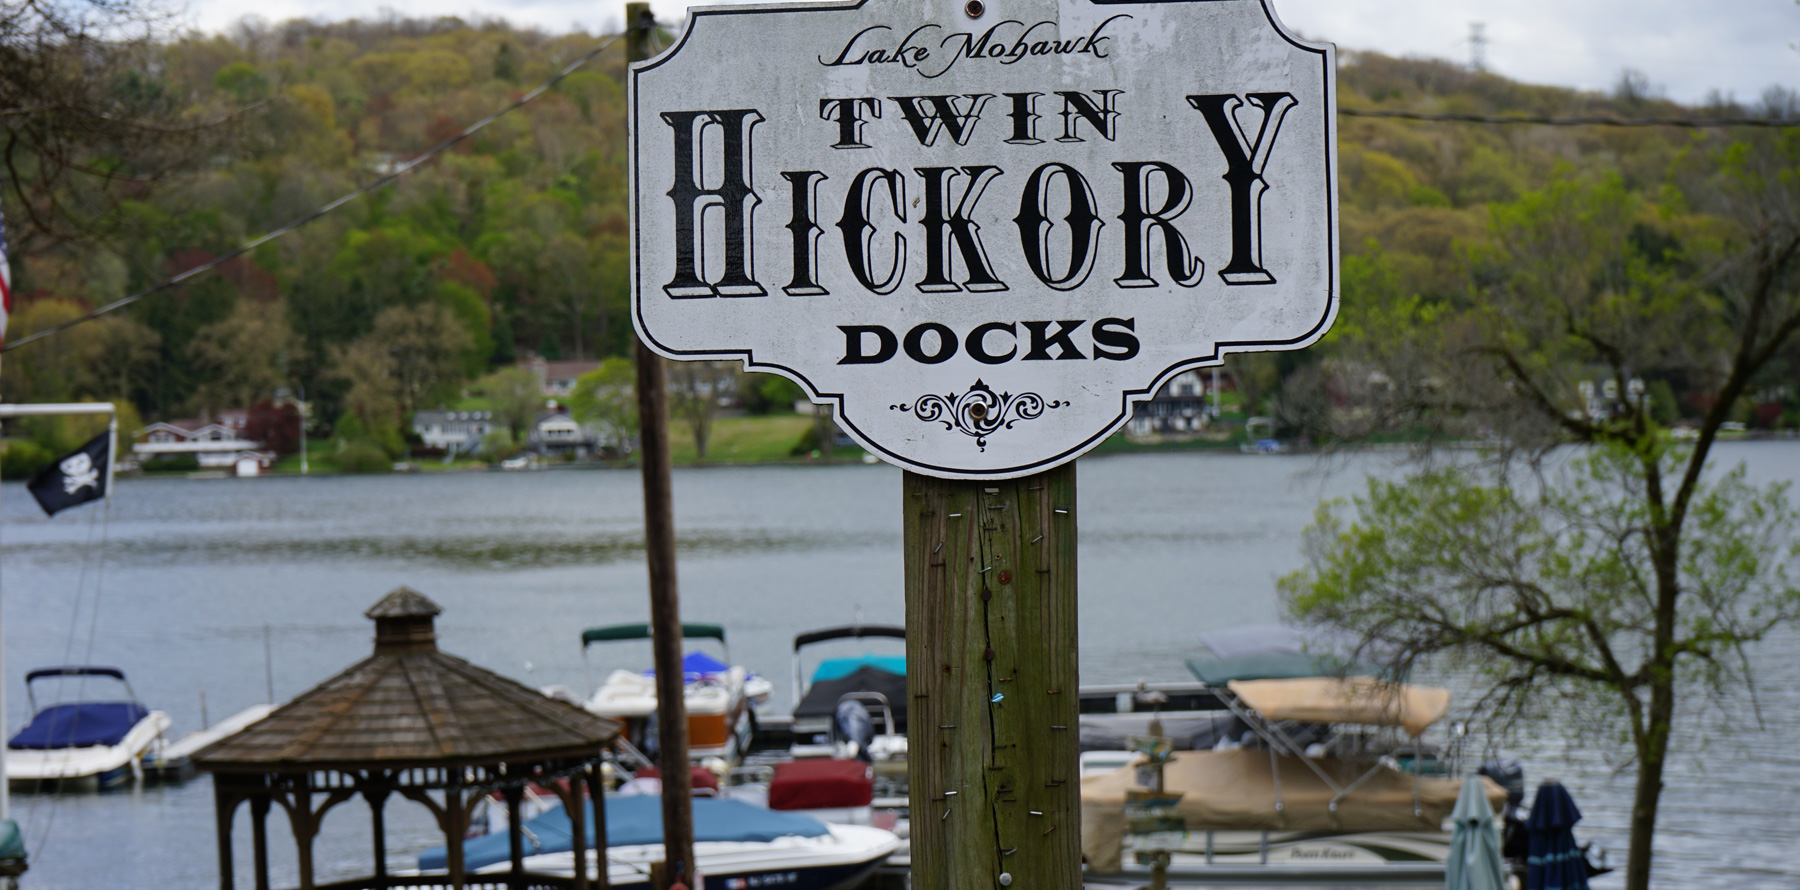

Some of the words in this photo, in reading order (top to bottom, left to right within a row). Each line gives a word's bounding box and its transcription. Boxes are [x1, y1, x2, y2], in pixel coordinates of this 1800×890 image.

[818, 25, 941, 67] Lake
[916, 14, 1133, 79] Mohawk
[820, 89, 1125, 149] TWIN
[660, 92, 1299, 298] HICKORY
[837, 317, 1140, 365] DOCKS
